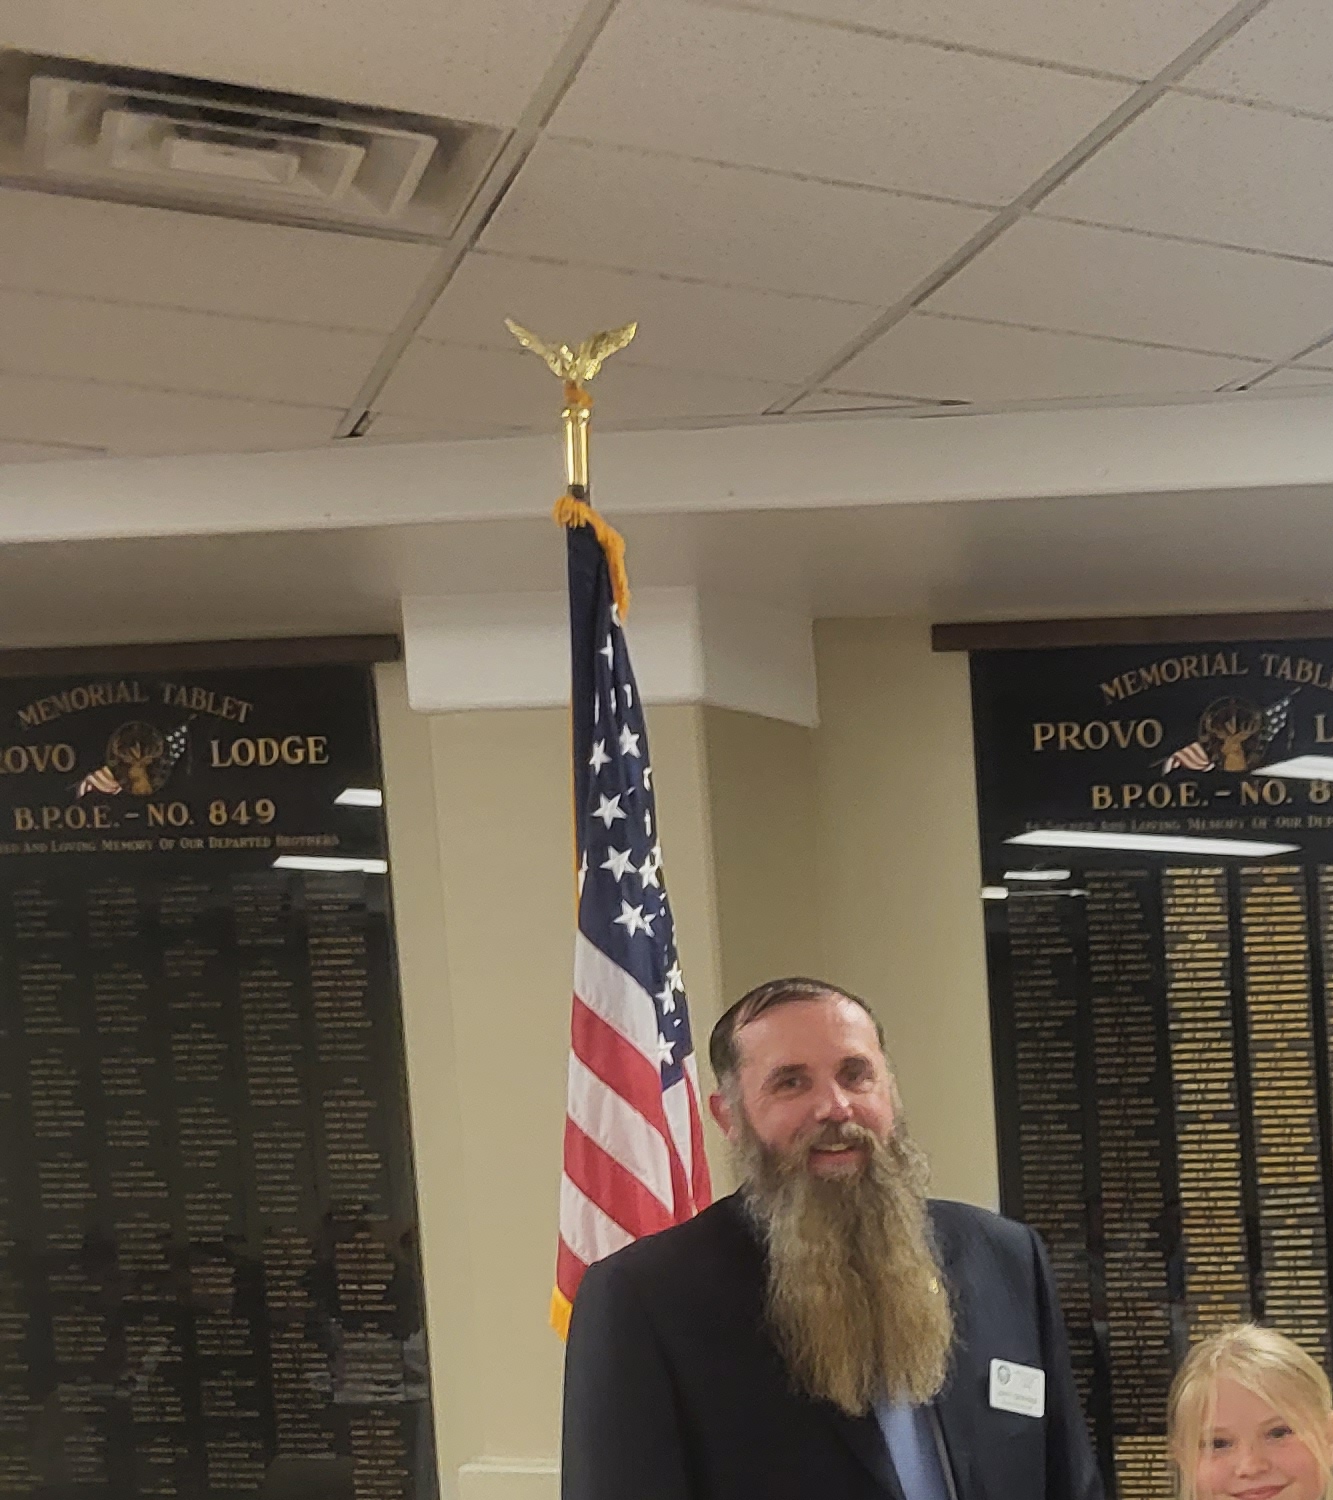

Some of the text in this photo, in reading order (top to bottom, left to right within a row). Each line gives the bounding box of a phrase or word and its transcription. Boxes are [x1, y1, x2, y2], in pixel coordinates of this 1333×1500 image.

[1099, 651, 1249, 705] MEMORIAL
[18, 681, 254, 729] MEMORIAL TABLET
[1033, 718, 1164, 753] PROVO
[0, 736, 330, 774] OVO LODGE
[1091, 782, 1209, 812] B.P.O.E.
[1240, 779, 1293, 808] NO.
[14, 802, 121, 831] B.P.O.E.
[147, 802, 195, 827] NO.
[208, 799, 277, 827] 849
